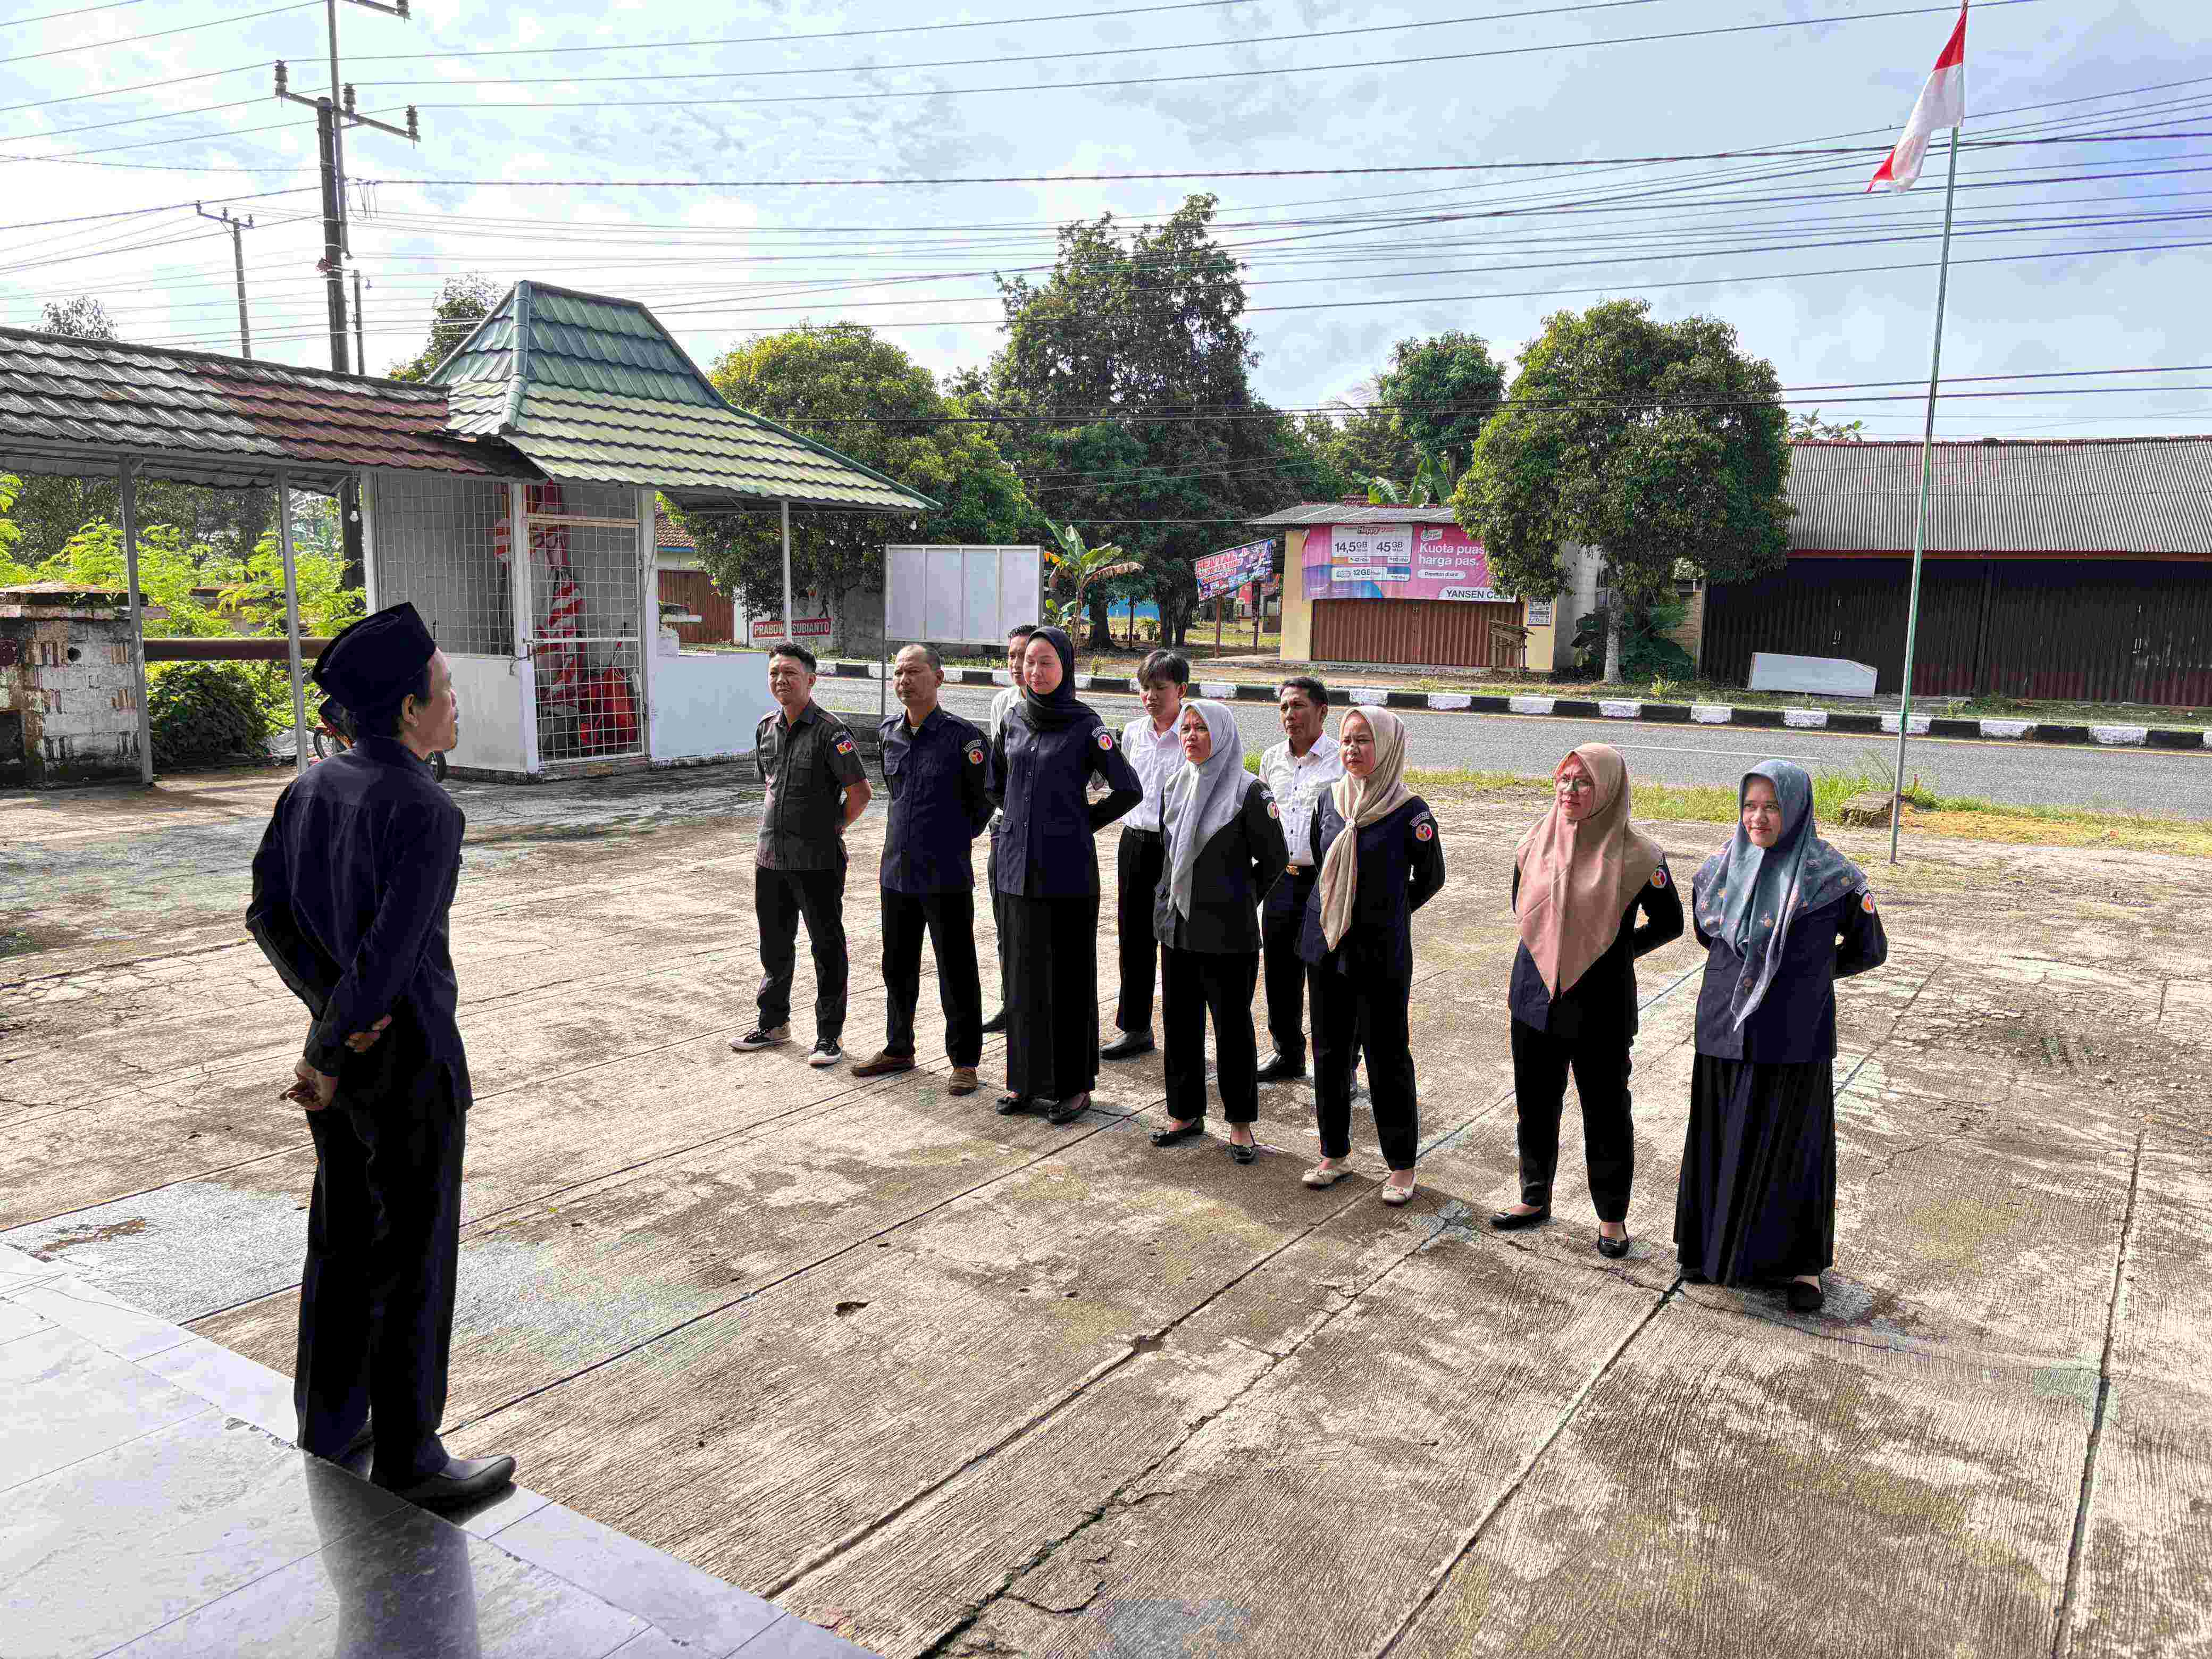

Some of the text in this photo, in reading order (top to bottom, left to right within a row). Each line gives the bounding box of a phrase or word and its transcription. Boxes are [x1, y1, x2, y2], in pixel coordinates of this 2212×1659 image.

[1419, 542, 1485, 556] Kuota puas
[1419, 555, 1479, 567] harga pas.
[1446, 589, 1485, 599] YANSEN
[754, 622, 830, 635] PRABOW SUBIANTO
